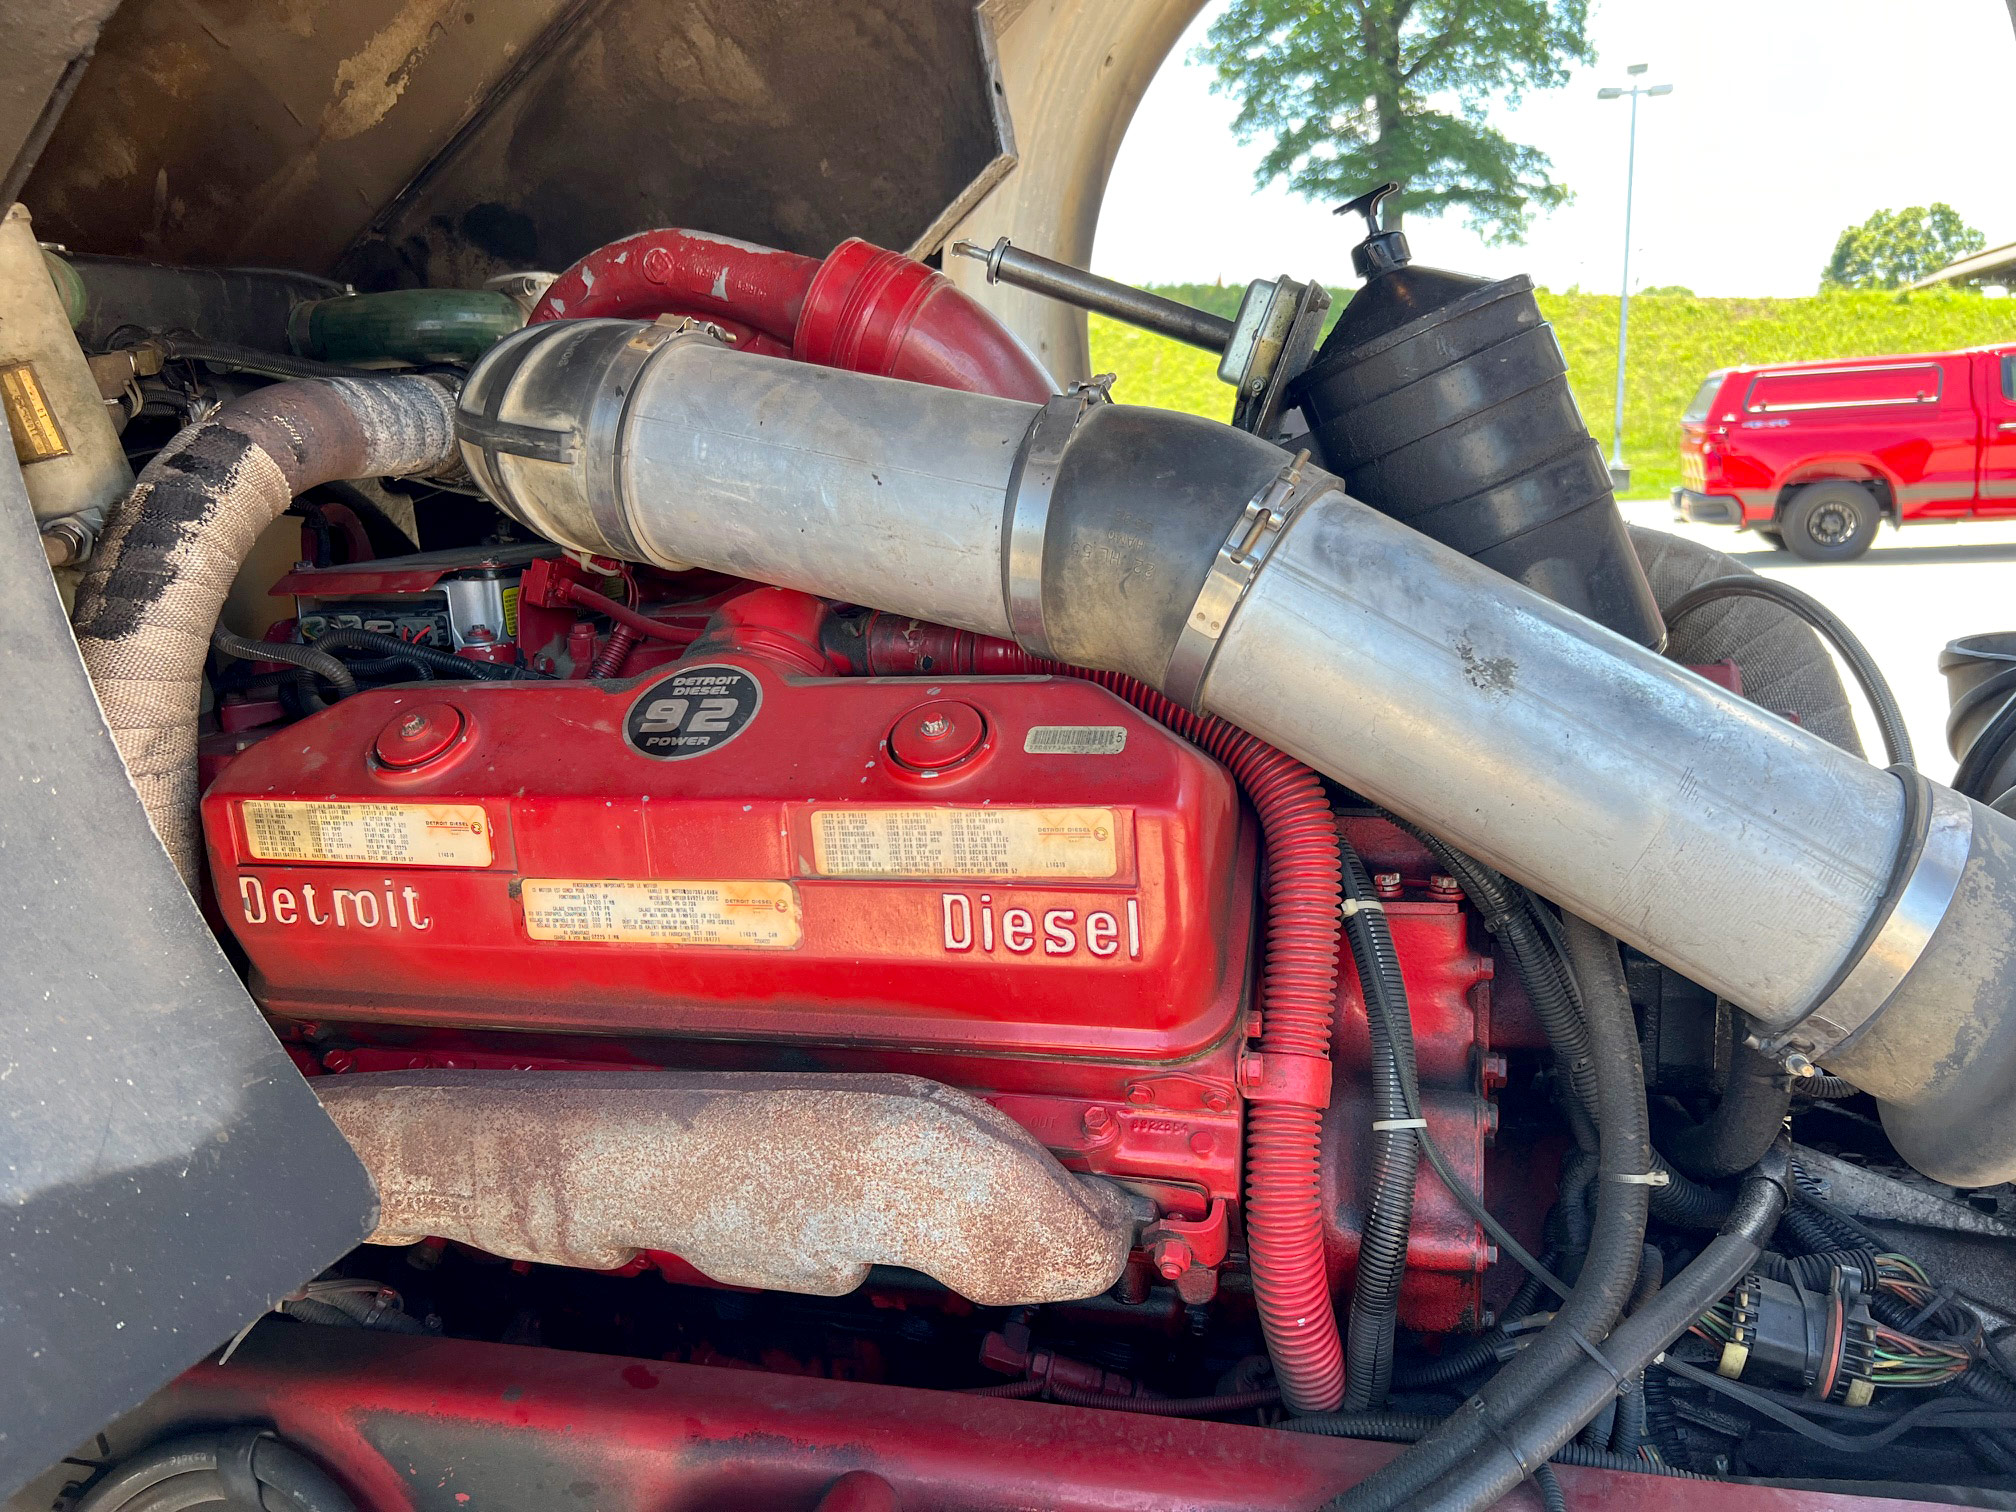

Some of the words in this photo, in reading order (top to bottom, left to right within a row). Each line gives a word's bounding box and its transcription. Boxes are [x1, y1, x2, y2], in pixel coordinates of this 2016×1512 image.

[672, 676, 741, 687] DETROIT
[672, 687, 729, 696] DIESEL
[639, 698, 739, 733] 92
[646, 736, 711, 747] POWER
[1116, 732, 1123, 743] 5
[238, 876, 429, 930] Detroit
[942, 893, 1140, 957] Diesel
